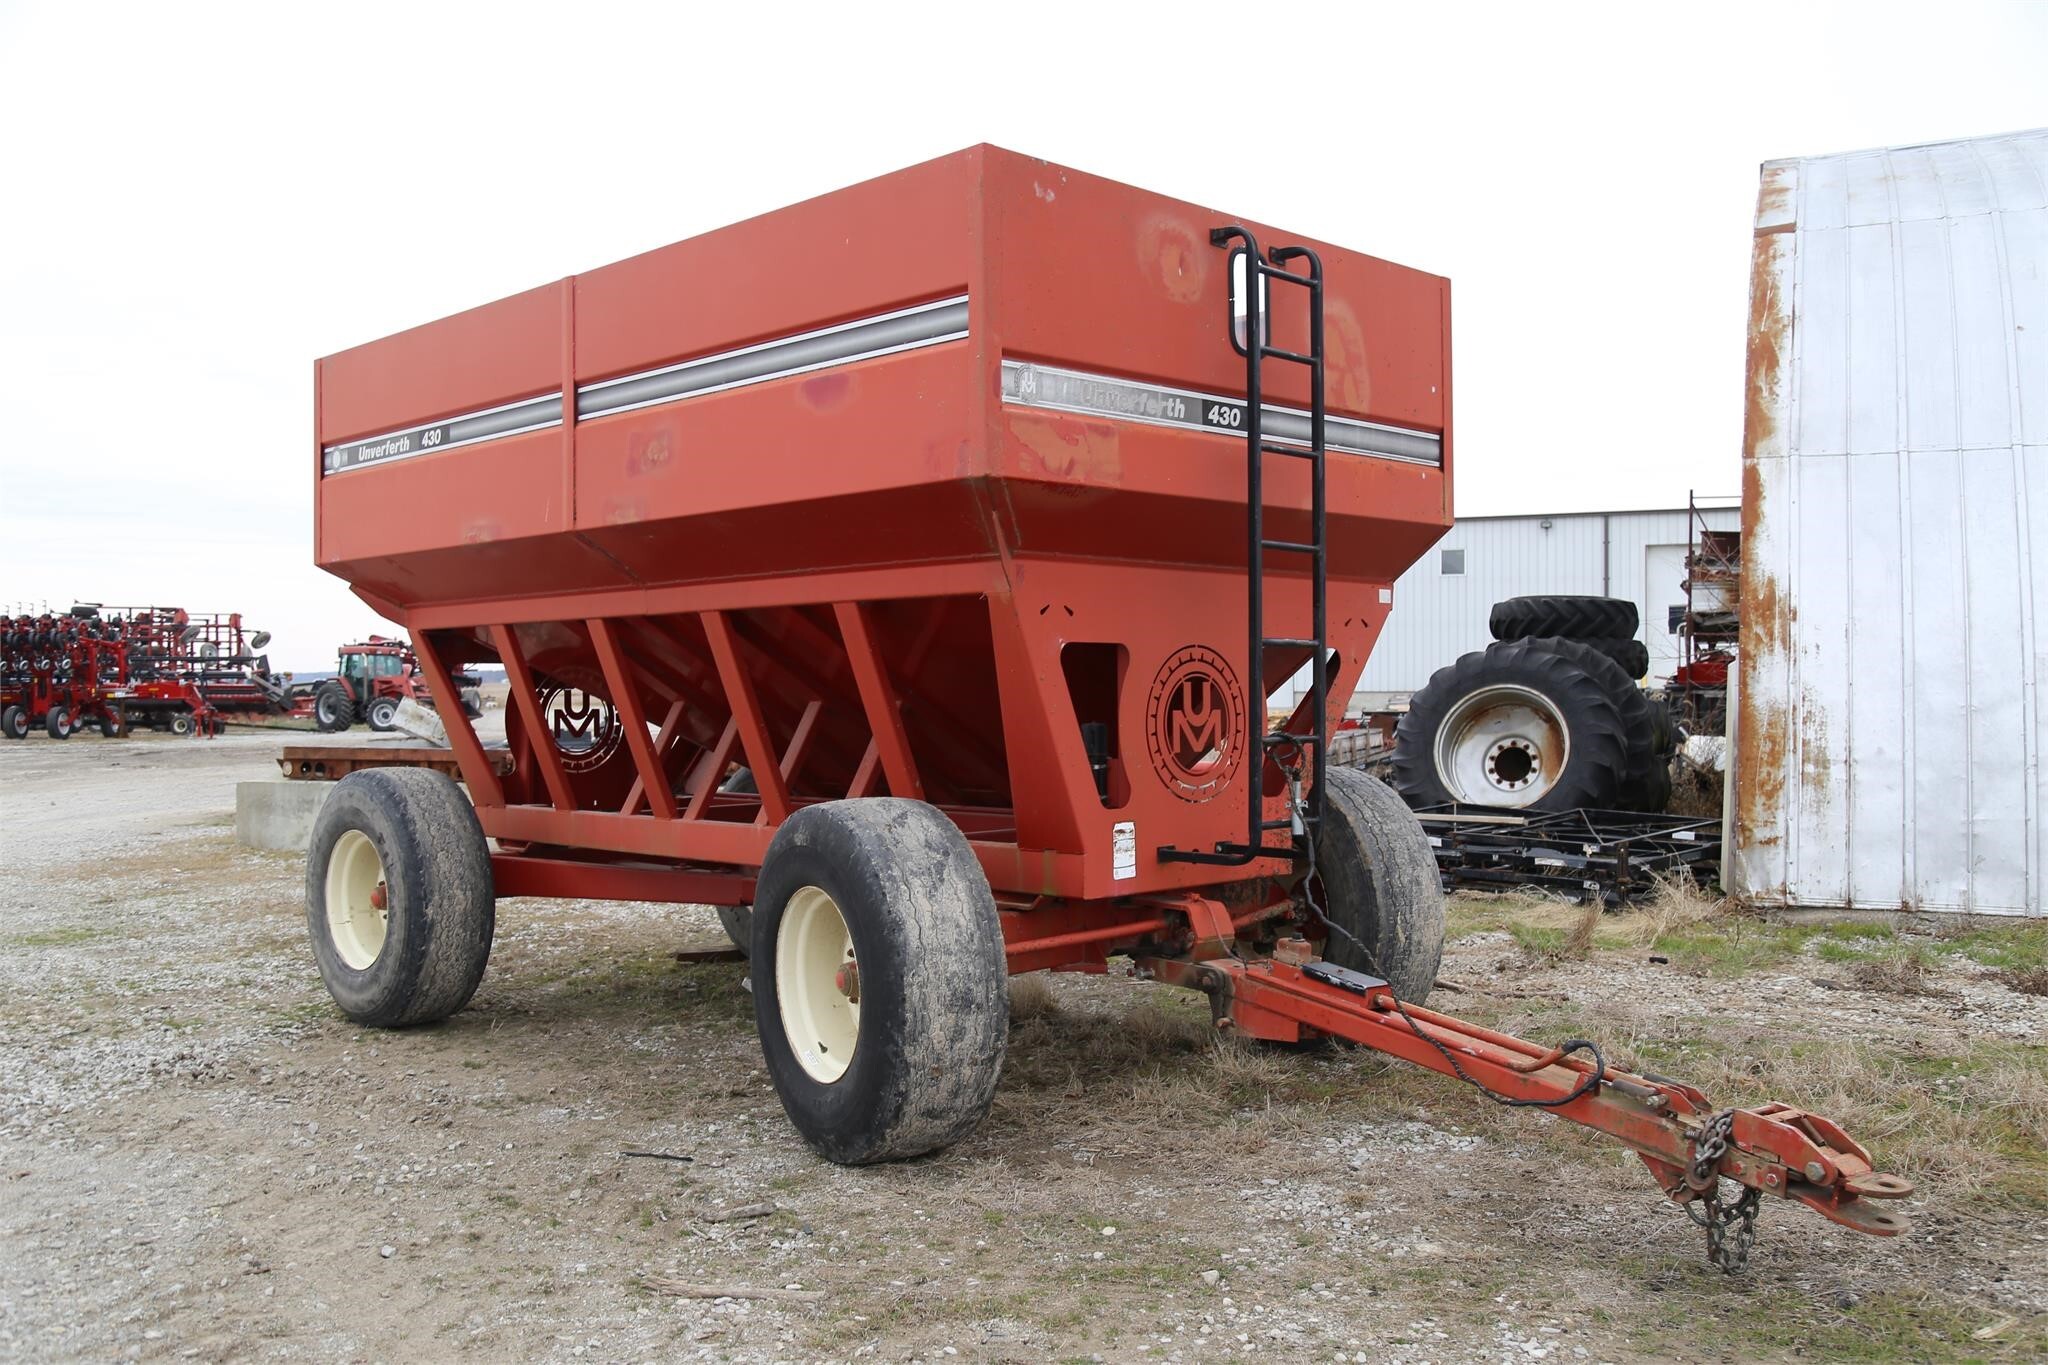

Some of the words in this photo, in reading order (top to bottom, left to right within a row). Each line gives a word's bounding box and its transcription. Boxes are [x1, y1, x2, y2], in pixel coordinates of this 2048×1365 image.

[1207, 405, 1241, 428] 430
[358, 436, 410, 461] Unverferth
[421, 428, 442, 447] 430
